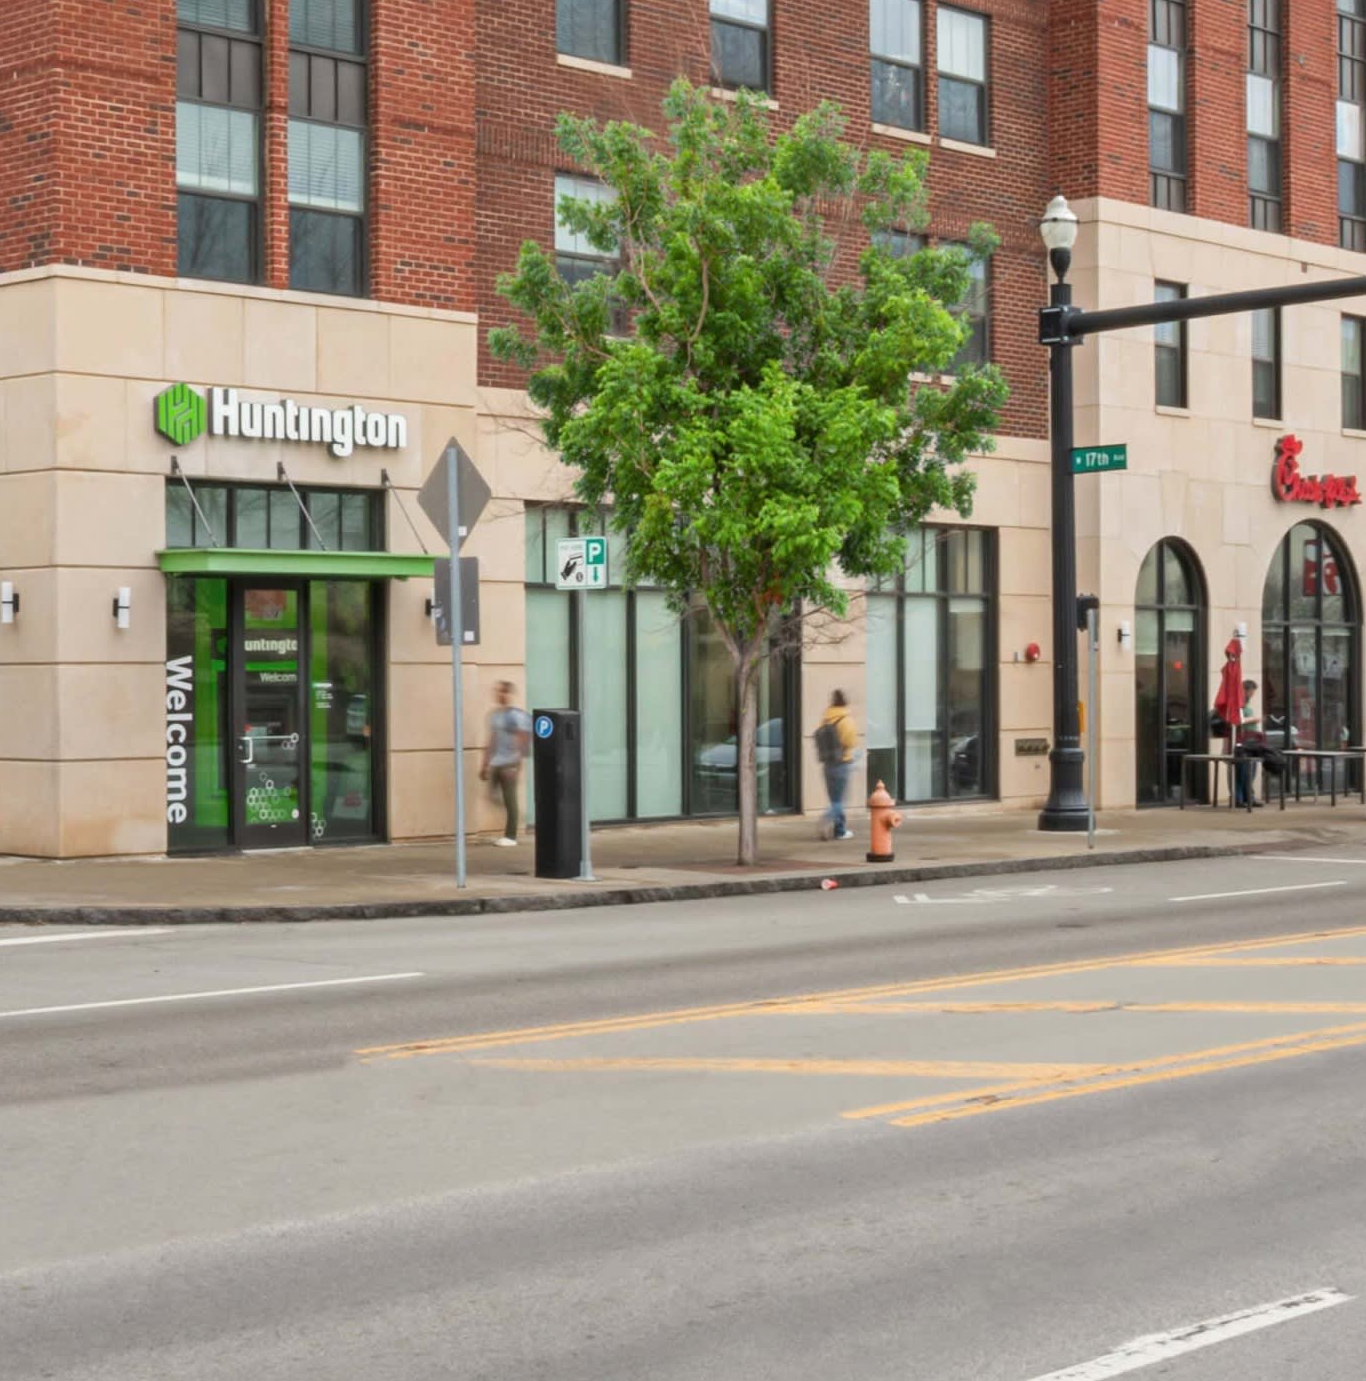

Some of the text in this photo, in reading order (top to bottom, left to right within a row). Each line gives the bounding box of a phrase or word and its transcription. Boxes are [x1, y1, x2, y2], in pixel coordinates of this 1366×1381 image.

[212, 387, 407, 457] Huntington
[1085, 451, 1110, 468] 17th
[588, 542, 602, 563] P
[166, 655, 193, 824] Welcome
